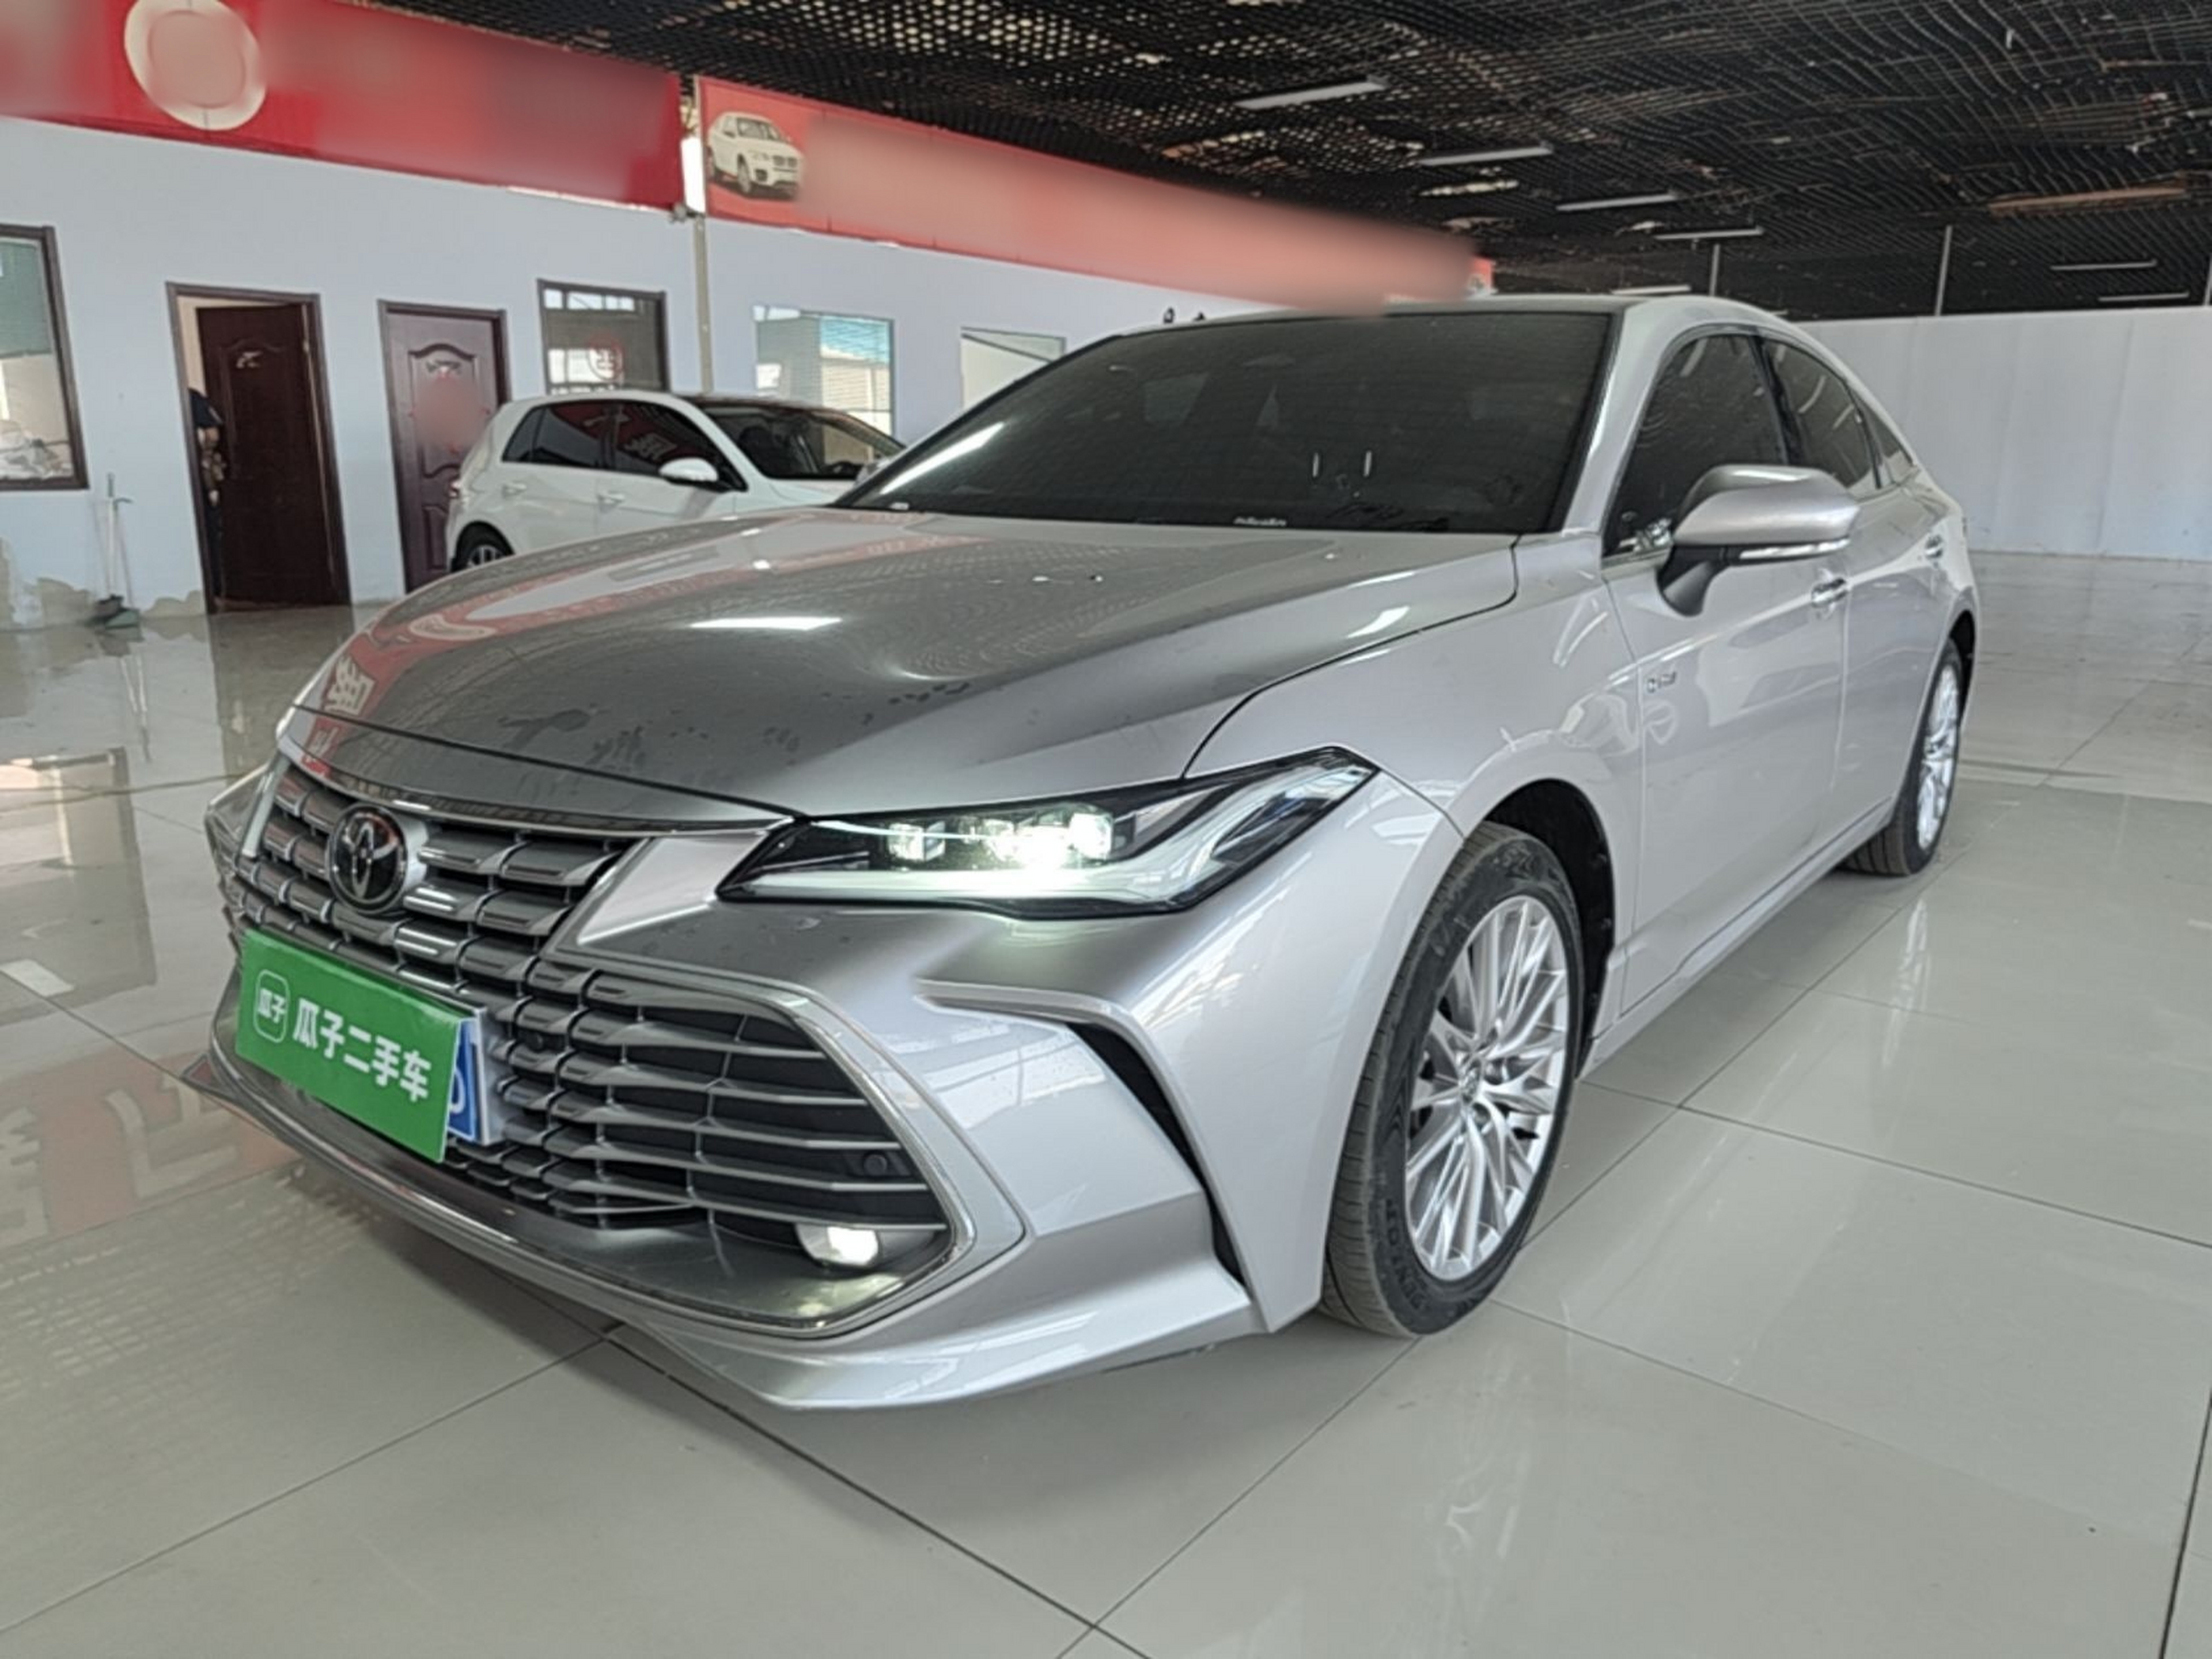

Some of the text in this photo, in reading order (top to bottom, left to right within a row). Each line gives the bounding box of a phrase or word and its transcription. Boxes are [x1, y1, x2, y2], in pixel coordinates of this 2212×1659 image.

[293, 997, 431, 1103] 瓜子二手车
